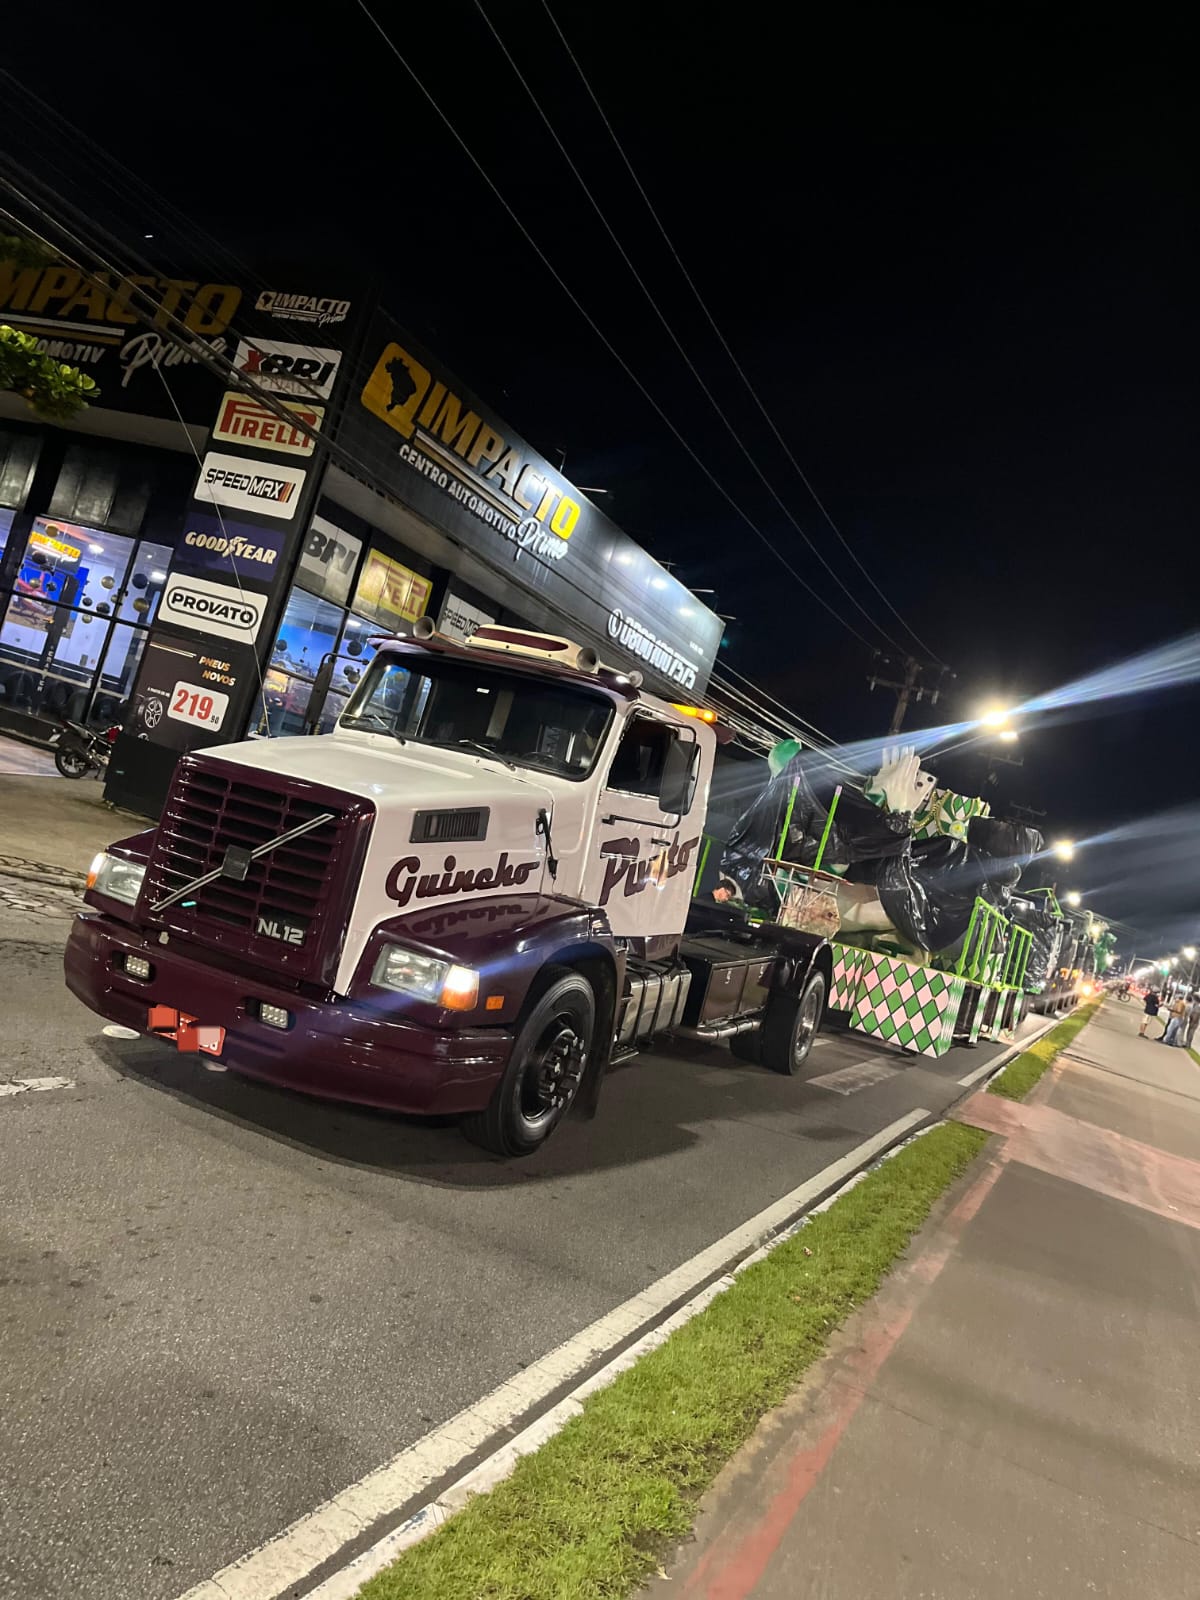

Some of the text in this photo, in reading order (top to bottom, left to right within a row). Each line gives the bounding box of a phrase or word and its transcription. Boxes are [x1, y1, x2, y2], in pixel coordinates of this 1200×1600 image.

[0, 262, 242, 336] MPACTO
[273, 292, 351, 315] IMPACTO
[35, 338, 106, 364] OMOTIV
[240, 350, 336, 387] XBRI
[219, 399, 317, 448] PIRELLI
[414, 377, 581, 540] IMPACTO
[204, 467, 290, 501] SPEEDMAX
[399, 444, 517, 541] CENTRO AUTOMOTIVO
[184, 531, 277, 564] GOODYEAR
[301, 529, 357, 575] BRI
[171, 593, 254, 624] PROVATO
[199, 656, 230, 671] PNEUS
[202, 670, 236, 686] NOVOS
[172, 688, 214, 720] 219
[385, 852, 540, 907] Guincho
[257, 917, 304, 945] NL12
